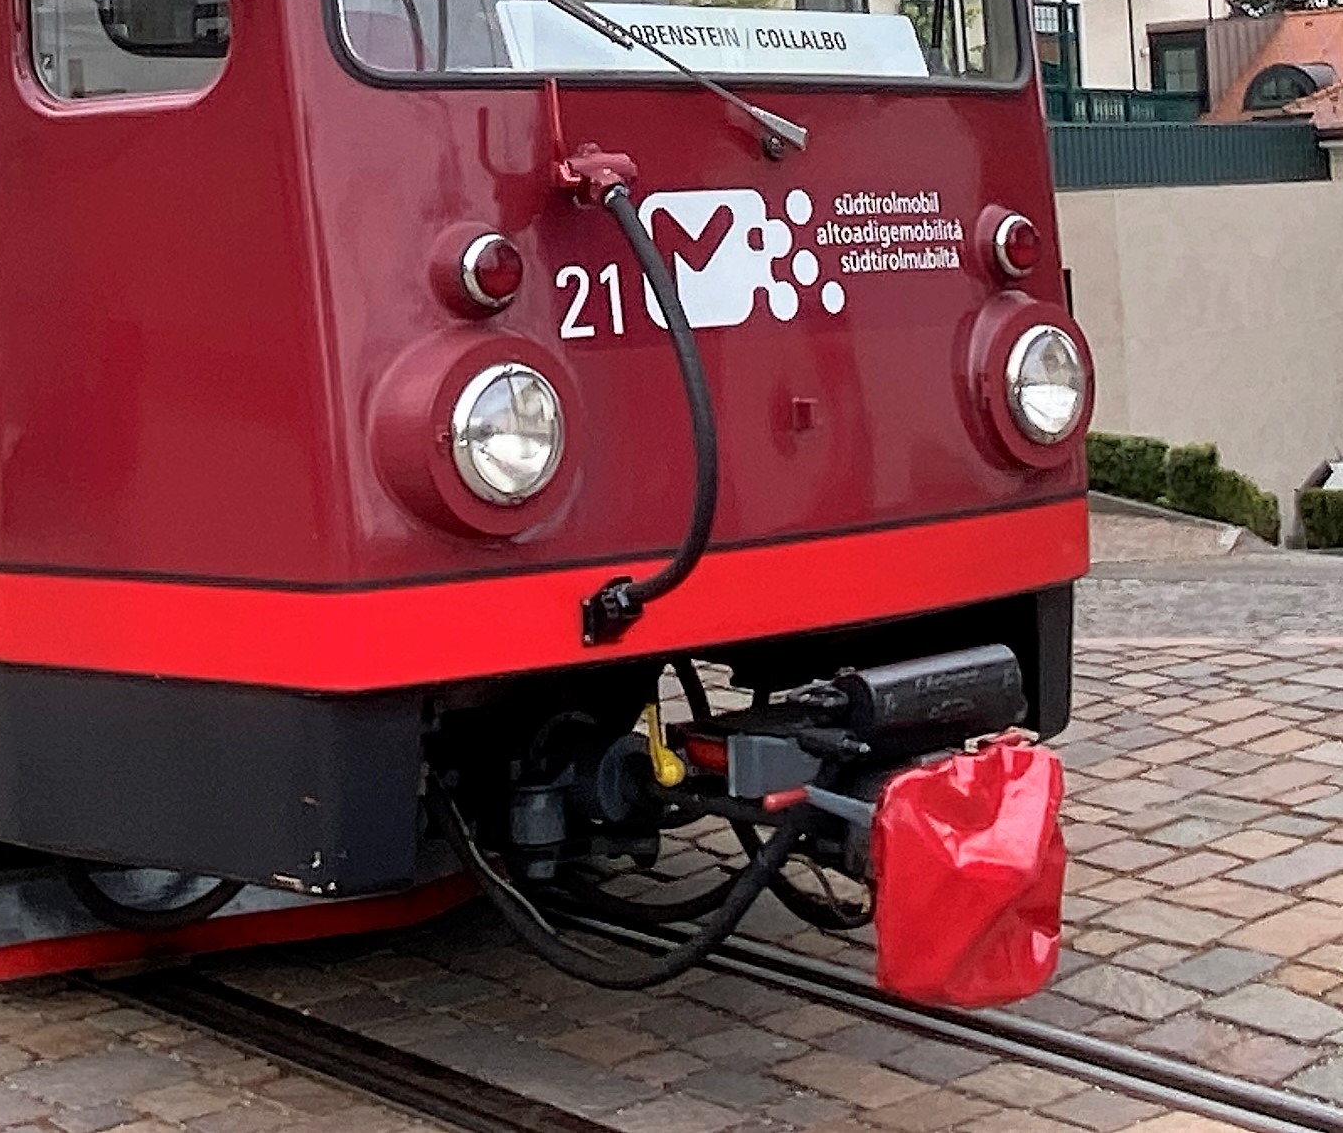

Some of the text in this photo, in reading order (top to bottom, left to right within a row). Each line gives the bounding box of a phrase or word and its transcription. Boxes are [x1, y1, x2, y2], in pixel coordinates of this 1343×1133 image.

[625, 24, 740, 48] OBENSTEIN
[756, 28, 847, 50] COLLALBO
[834, 191, 940, 215] südtirolmobil
[817, 217, 963, 248] altoadigemobilità
[556, 263, 624, 339] 21
